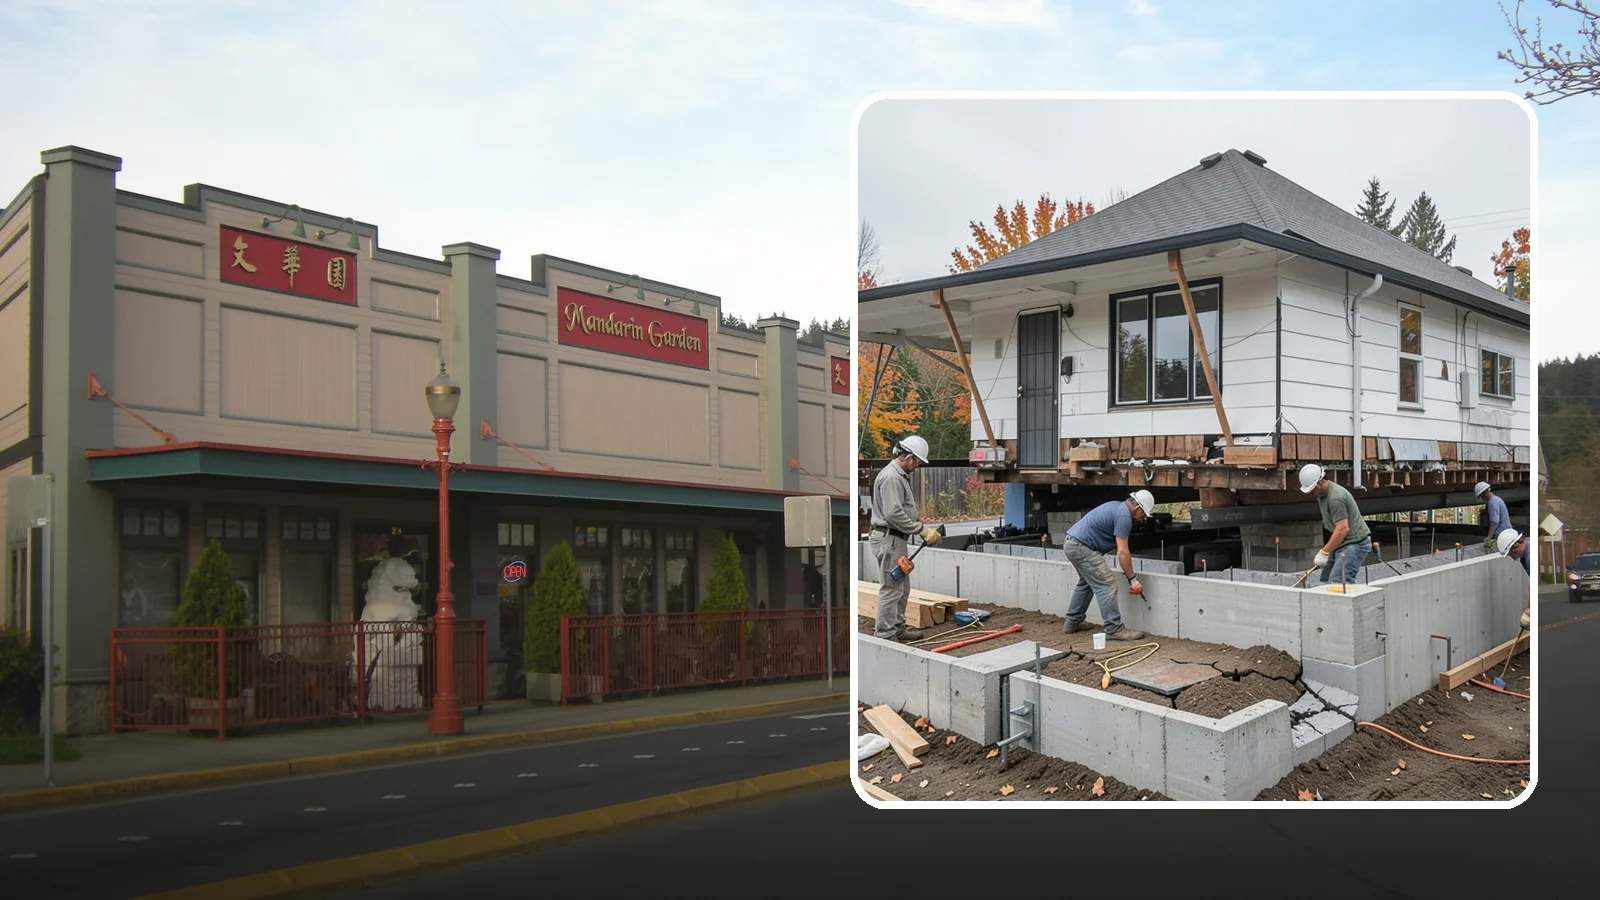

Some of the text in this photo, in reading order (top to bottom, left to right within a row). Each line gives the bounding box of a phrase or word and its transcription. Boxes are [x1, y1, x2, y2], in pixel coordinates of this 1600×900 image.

[231, 236, 346, 290] 文華園
[564, 302, 701, 352] Mandarin Garden
[503, 565, 527, 578] OPEN
